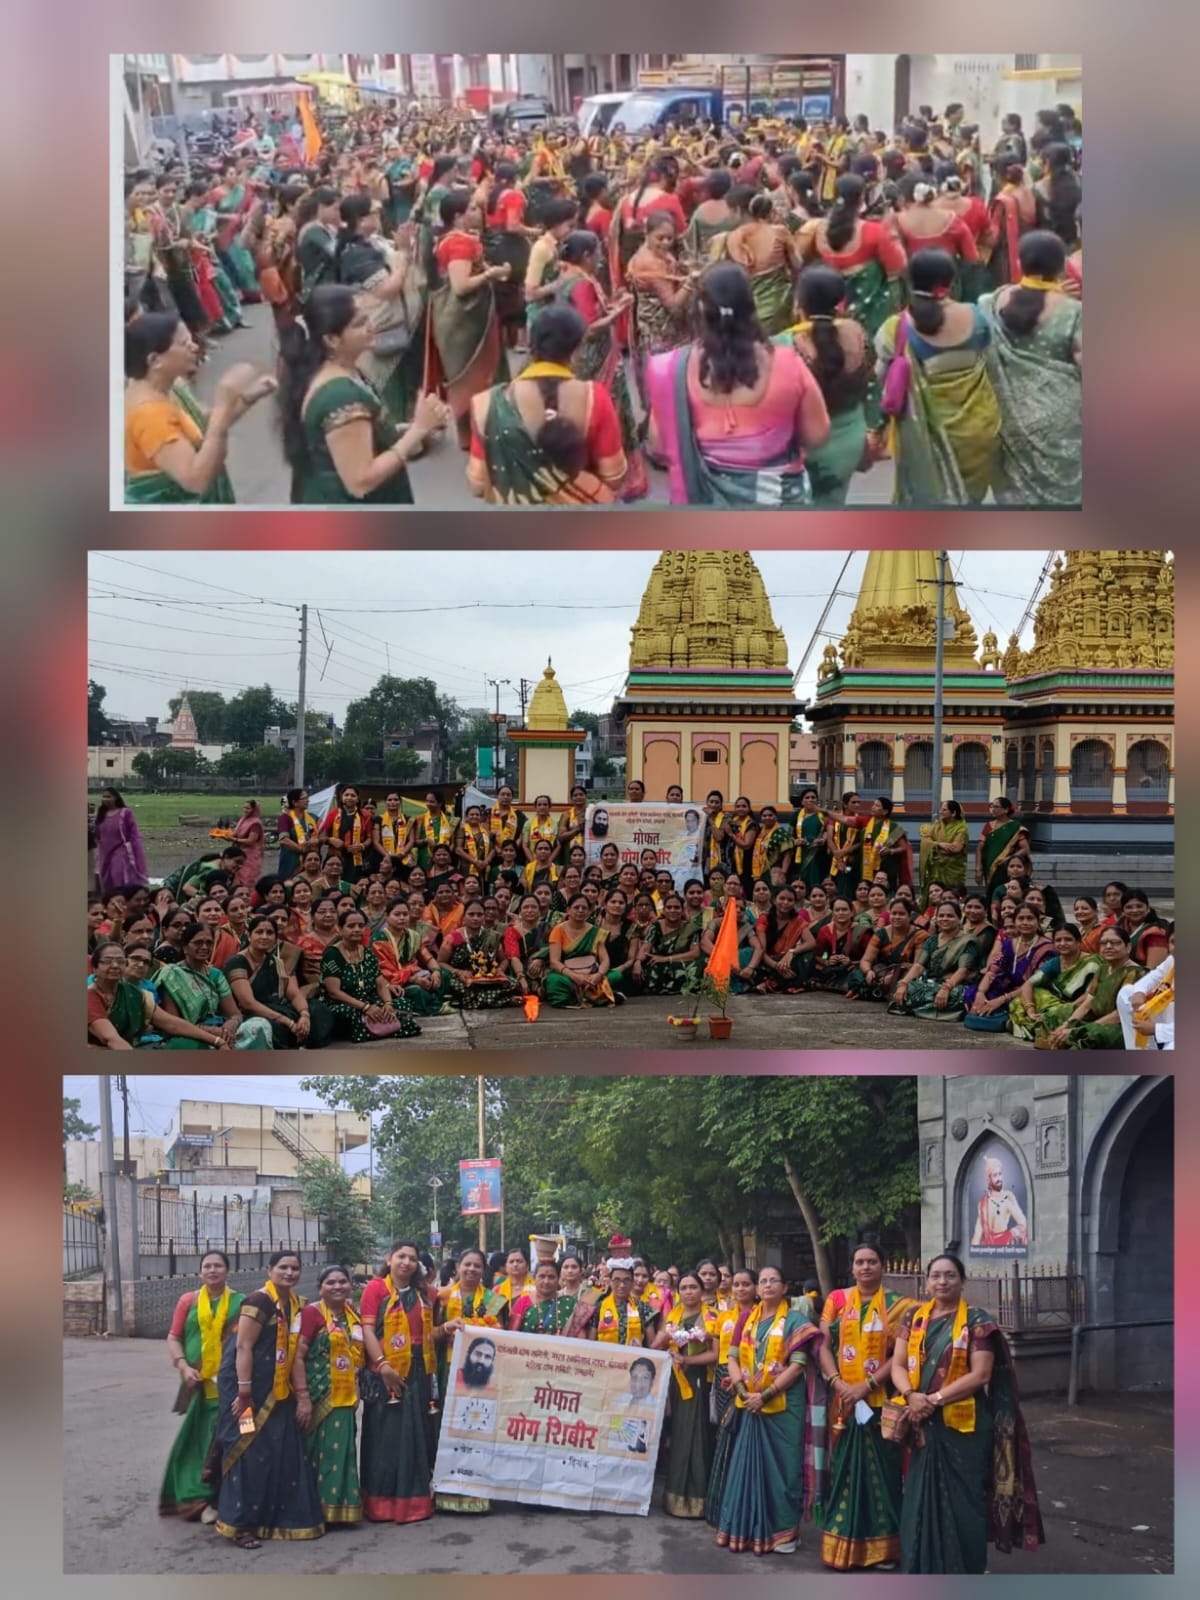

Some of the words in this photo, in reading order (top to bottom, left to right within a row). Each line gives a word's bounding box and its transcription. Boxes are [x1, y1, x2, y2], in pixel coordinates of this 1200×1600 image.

[632, 828, 660, 845] मोफत
[620, 848, 639, 865] योग
[533, 1381, 582, 1413] मोफत
[507, 1412, 541, 1442] योग
[545, 1416, 598, 1450] शिबीर
